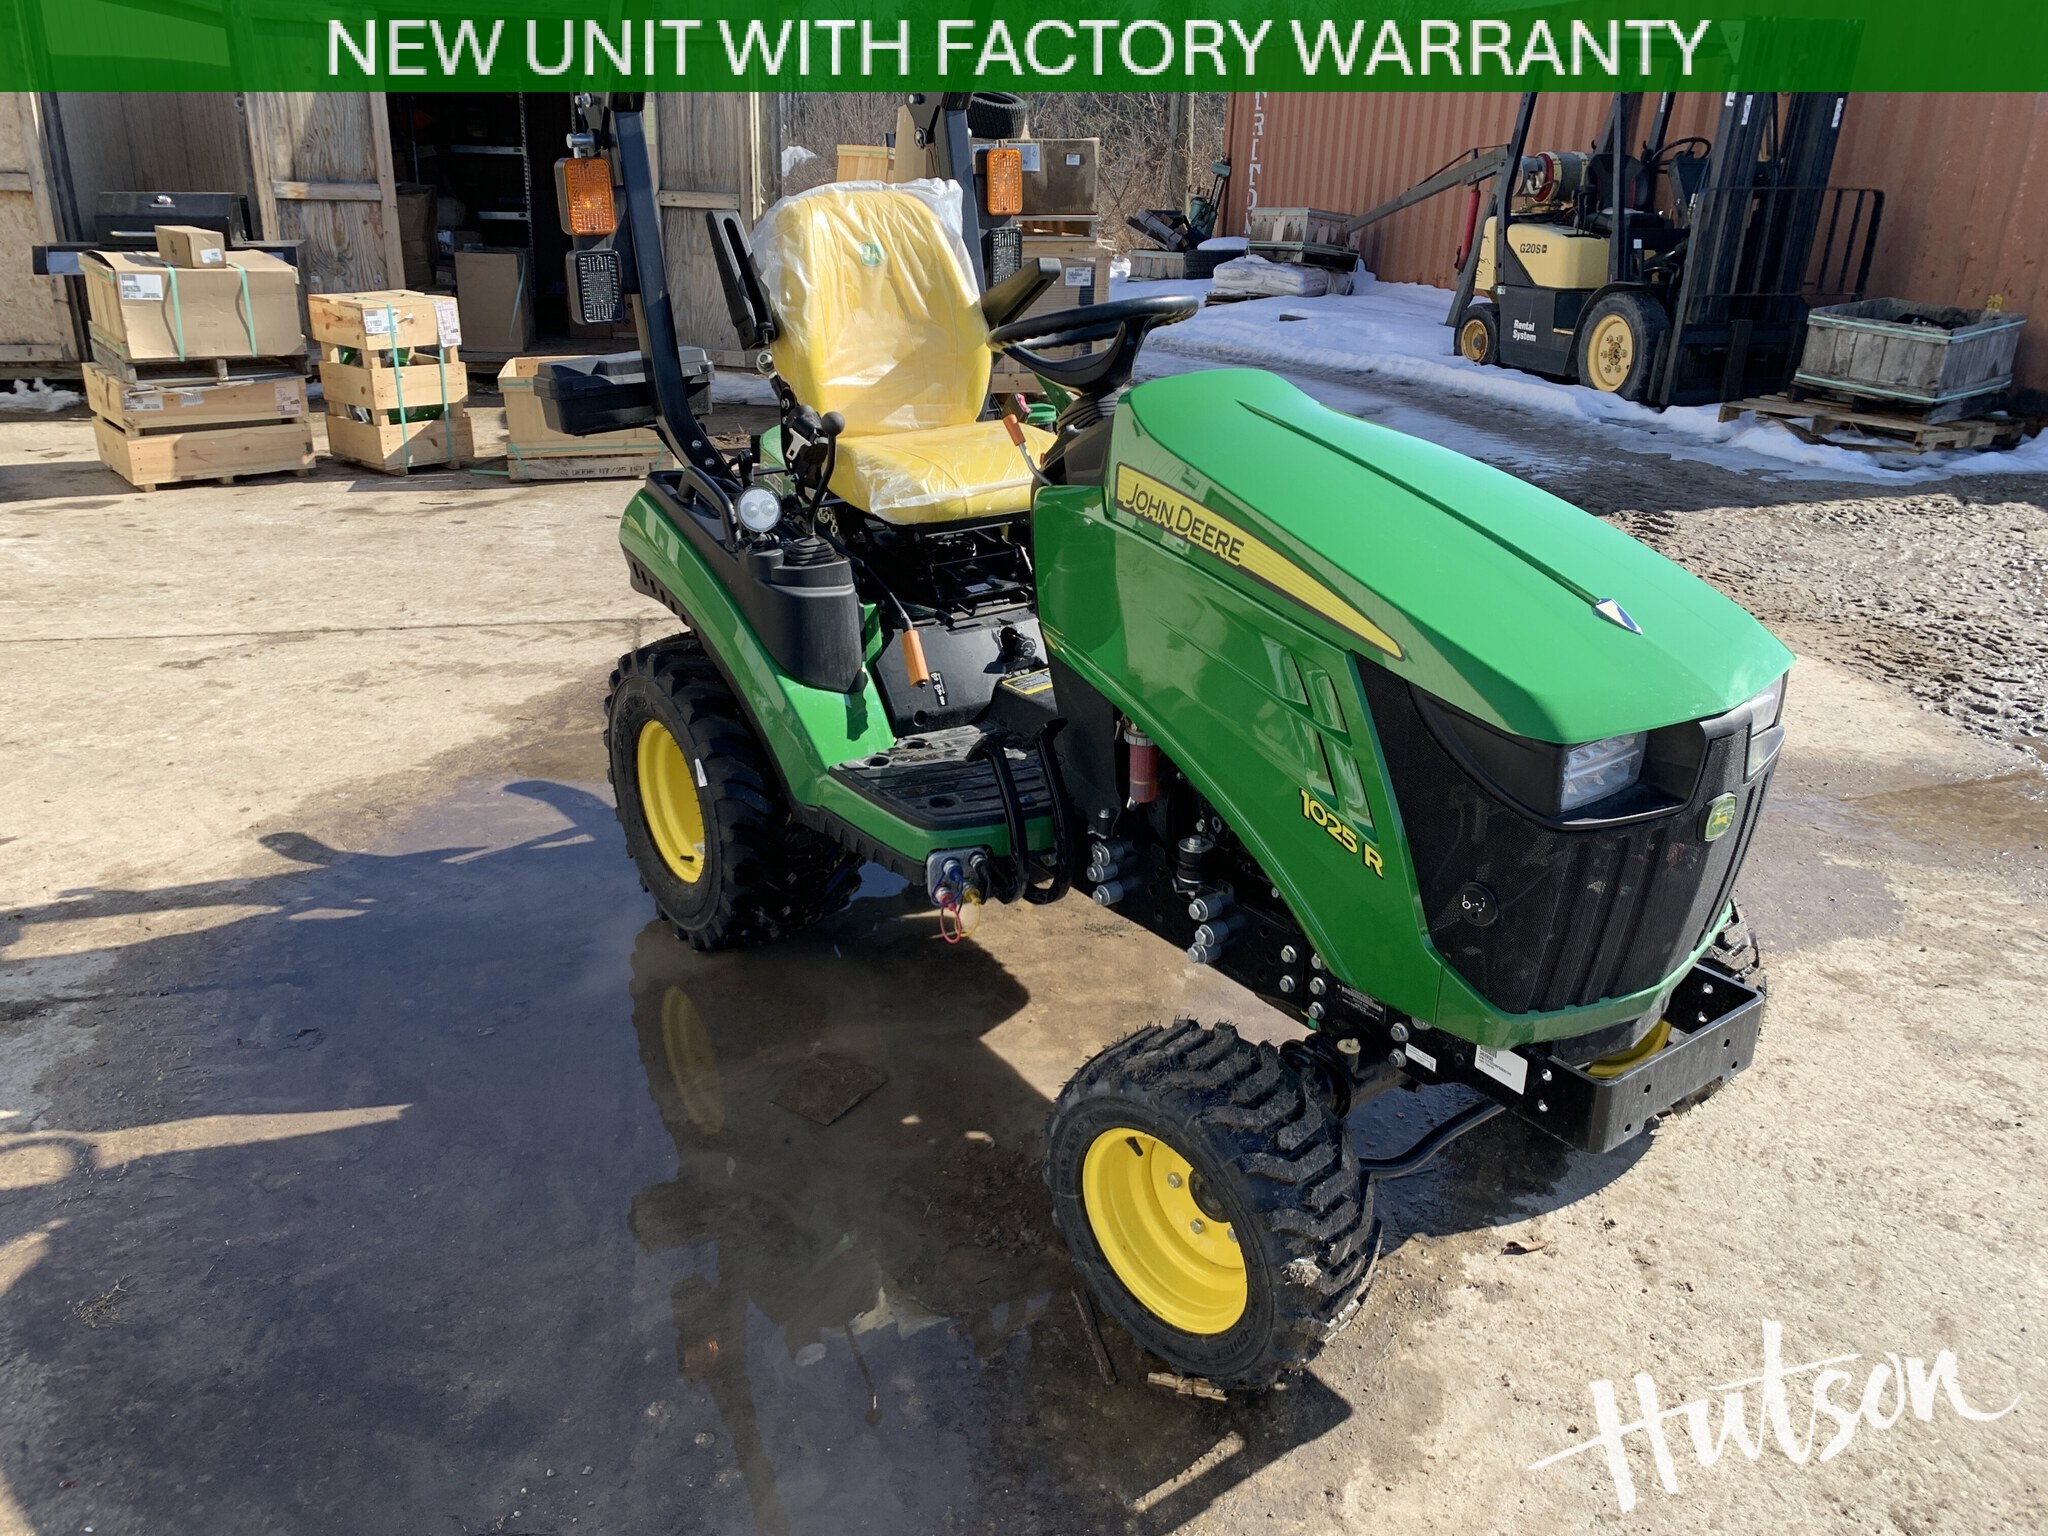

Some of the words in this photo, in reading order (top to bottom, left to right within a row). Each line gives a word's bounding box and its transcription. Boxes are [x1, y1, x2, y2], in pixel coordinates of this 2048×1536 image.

[1512, 329, 1537, 342] System
[1513, 319, 1536, 332] Rental
[1125, 483, 1175, 525] JOHN
[1175, 505, 1245, 562] DEERE
[1299, 787, 1359, 854] 1025
[1363, 842, 1384, 880] R
